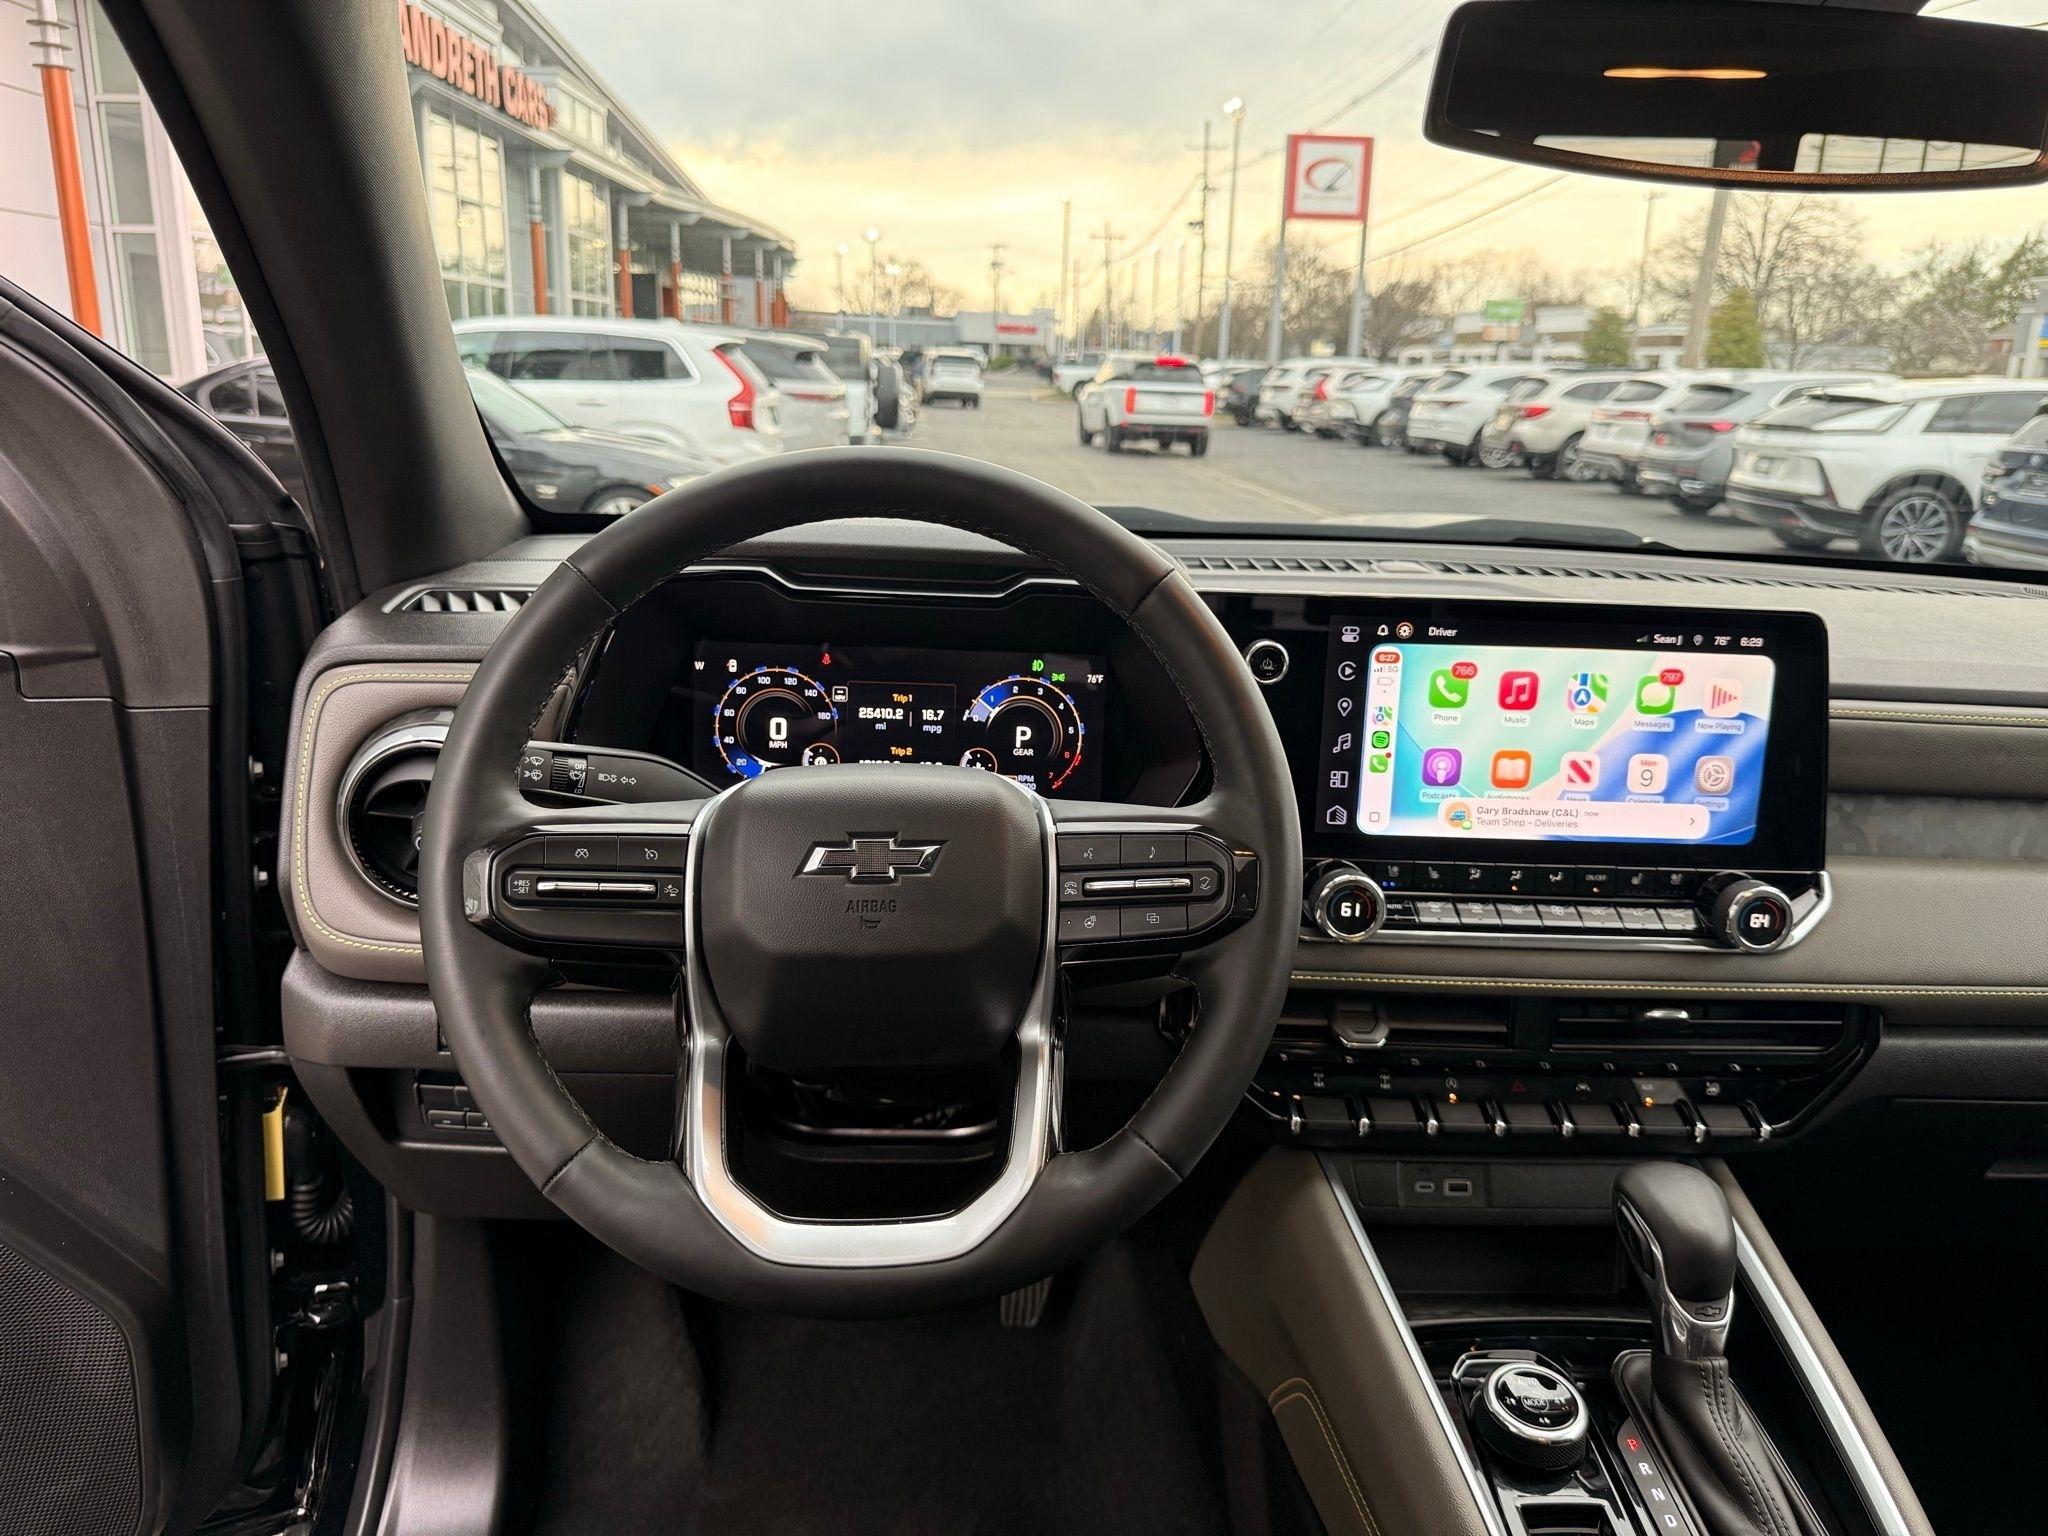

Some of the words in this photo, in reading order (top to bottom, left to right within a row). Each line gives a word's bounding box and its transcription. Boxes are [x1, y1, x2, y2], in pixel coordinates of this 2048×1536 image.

[1428, 626, 1458, 637] Driver
[1653, 634, 1676, 644] Sean
[1740, 637, 1764, 647] 6:29
[694, 661, 705, 671] W
[1387, 665, 1399, 673] 5G
[1454, 665, 1475, 675] 766
[757, 676, 771, 685] 100
[784, 677, 798, 686] 120
[736, 686, 747, 695] 80
[804, 688, 818, 698] 140
[1037, 687, 1044, 695] 3
[892, 693, 908, 704] Trip
[1058, 702, 1065, 710] 4
[723, 708, 735, 717] 60
[817, 711, 831, 720] 160
[858, 706, 904, 720] 25410.2
[921, 709, 945, 721] 16.7
[1434, 713, 1458, 722] Phone
[1504, 715, 1527, 724] Music
[1573, 717, 1596, 727] Maps
[769, 717, 787, 741] 0
[874, 721, 887, 731] mi
[922, 725, 942, 734] mpg
[1068, 726, 1075, 734] 5
[1633, 720, 1671, 730] Messages
[1697, 721, 1713, 730] Now
[1715, 722, 1742, 733] Playing
[723, 735, 735, 744] 40
[1015, 726, 1032, 748] P
[768, 740, 788, 749] MPH
[889, 746, 905, 757] Trip
[905, 747, 913, 756] 2
[735, 757, 747, 766] 20
[1640, 759, 1657, 767] Mon
[574, 763, 586, 771] OFF
[1640, 769, 1653, 787] 9
[1422, 791, 1457, 800] Podcasts
[1476, 806, 1499, 816] Gary
[1502, 807, 1549, 816] Bradshaw
[1551, 808, 1579, 818] (C&L)
[1476, 817, 1500, 826] Team
[1534, 819, 1578, 828] Deliveries
[846, 899, 897, 913] AIRBAG
[1340, 902, 1361, 917] 61
[1750, 913, 1769, 928] 64
[1523, 1399, 1547, 1407] MODE
[1626, 1438, 1638, 1452] P
[1638, 1462, 1653, 1476] R
[1651, 1488, 1665, 1501] N
[1663, 1514, 1677, 1528] D
